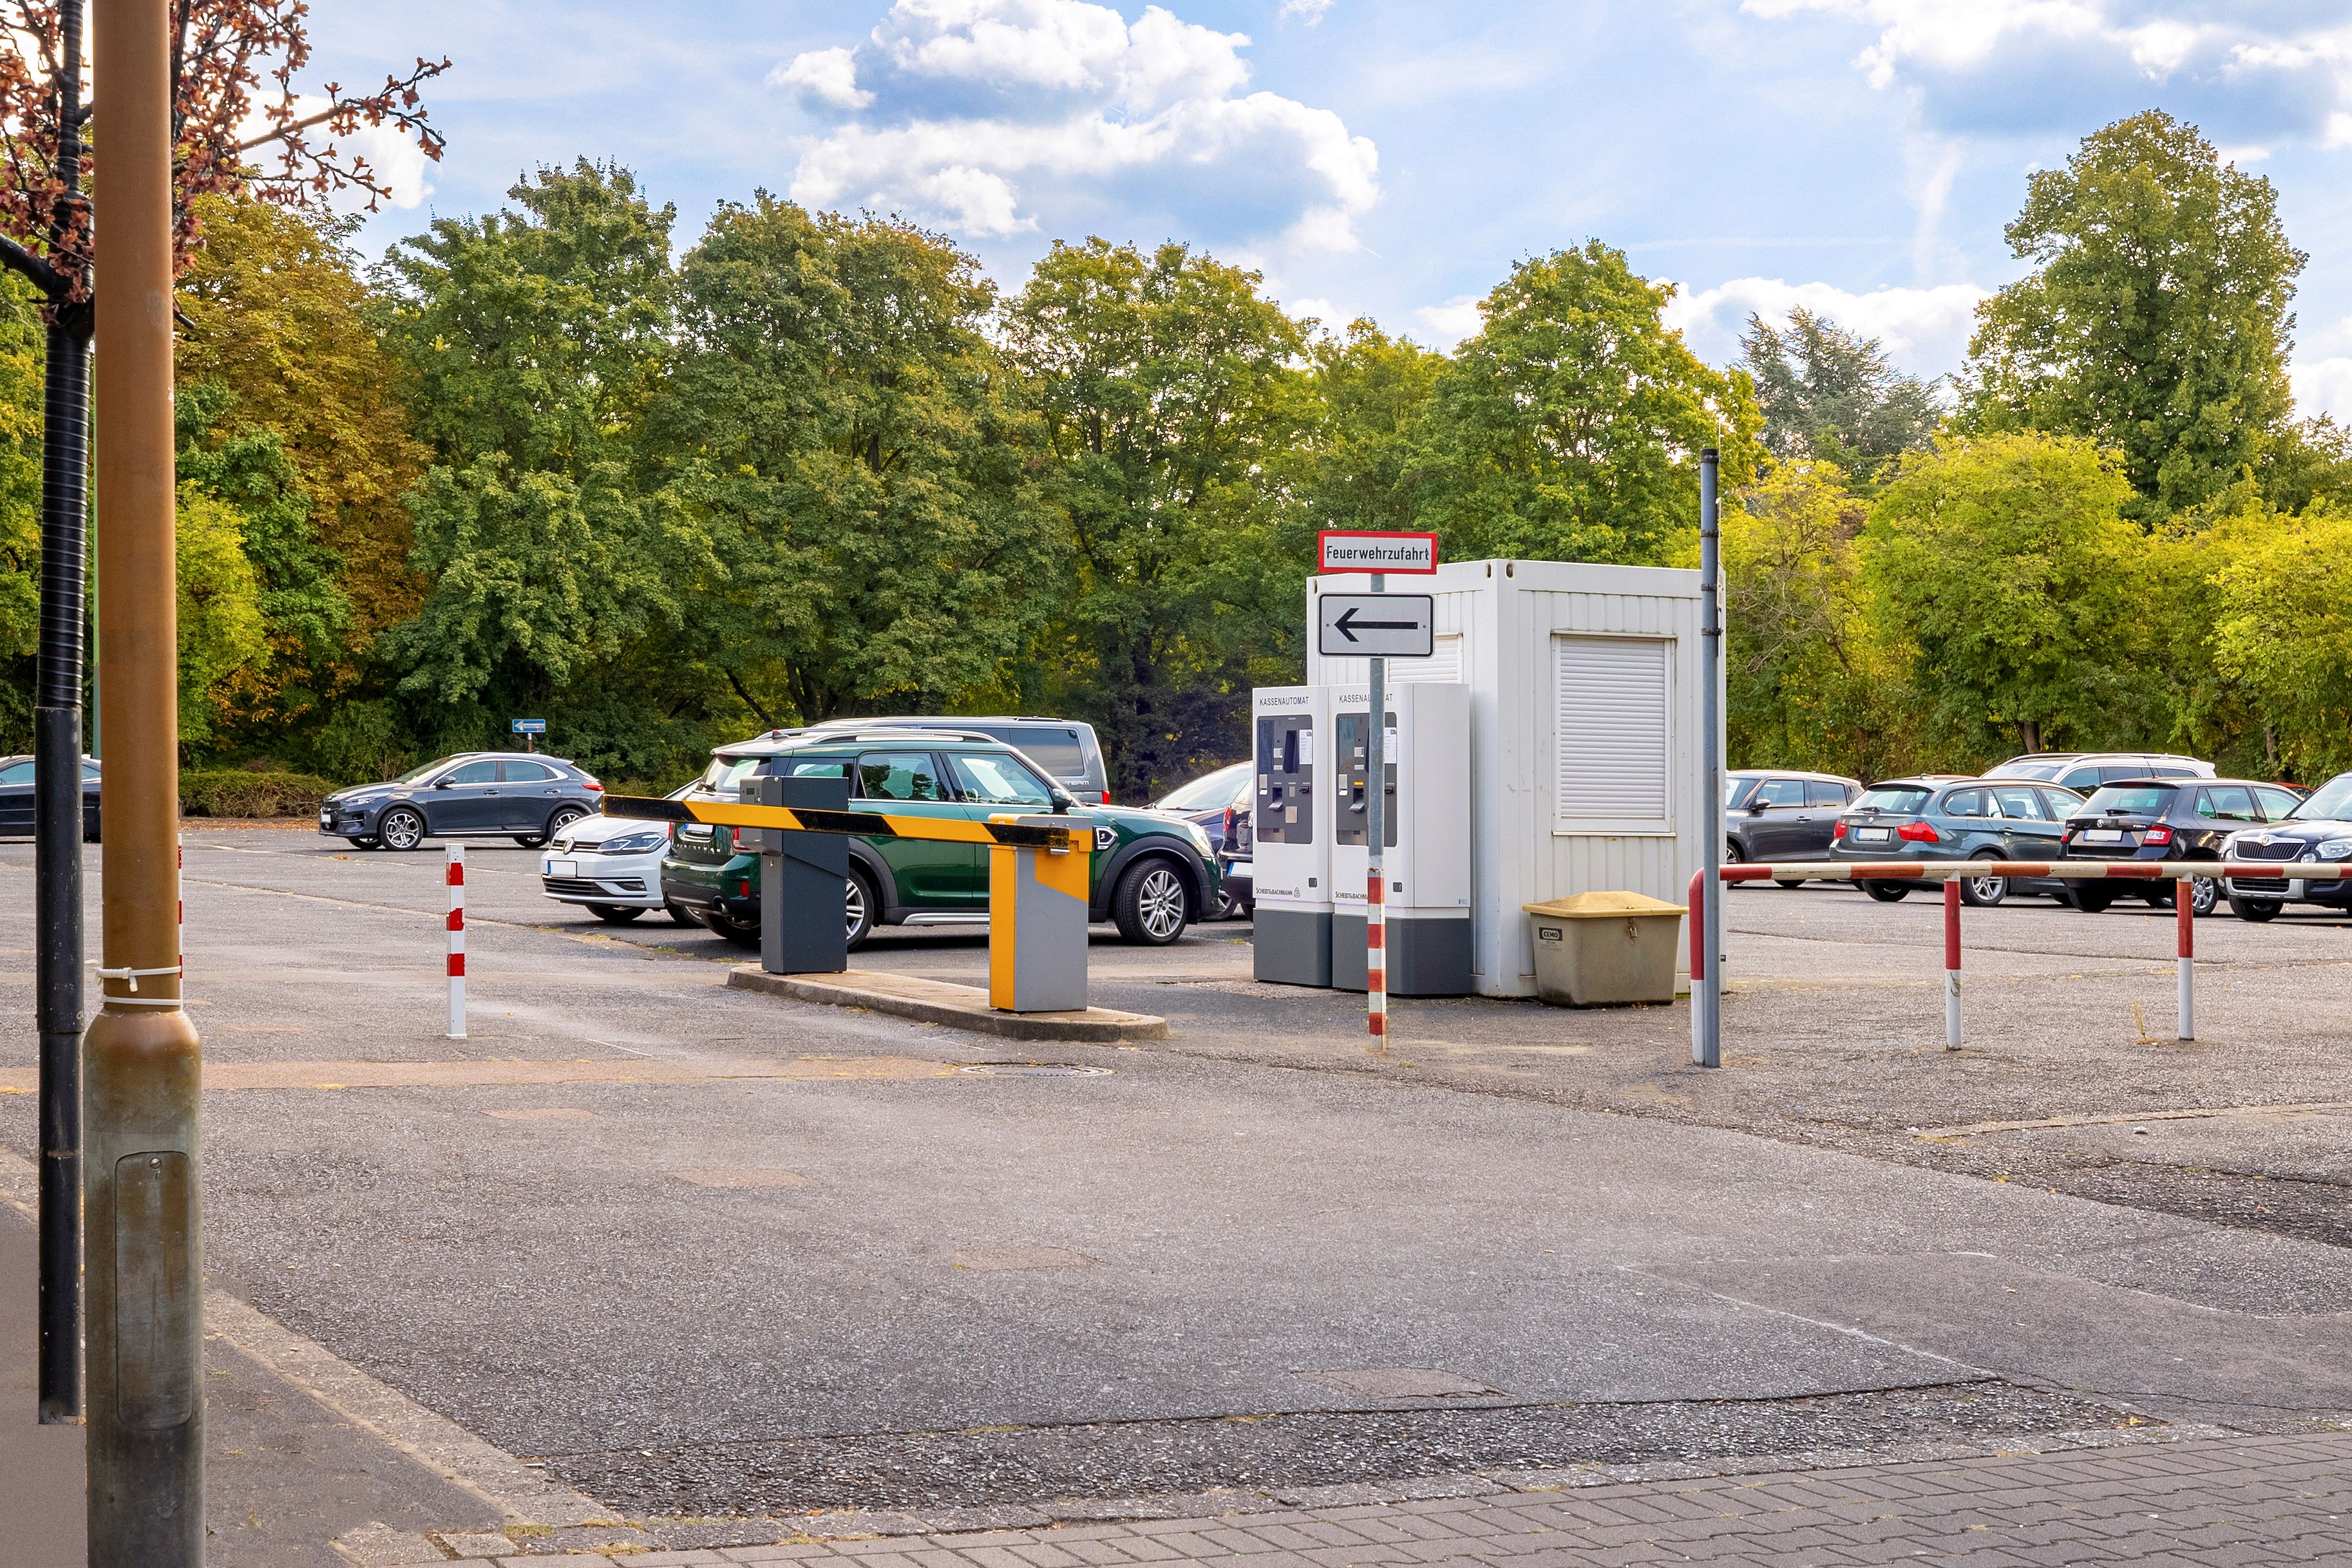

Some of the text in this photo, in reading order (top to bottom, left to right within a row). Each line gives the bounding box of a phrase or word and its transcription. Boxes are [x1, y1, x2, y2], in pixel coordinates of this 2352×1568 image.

[1327, 545, 1429, 560] Feuerwehrzufahrt
[1259, 696, 1309, 706] KASSENAUTOMAT
[1339, 694, 1393, 703] KASSENAUAT
